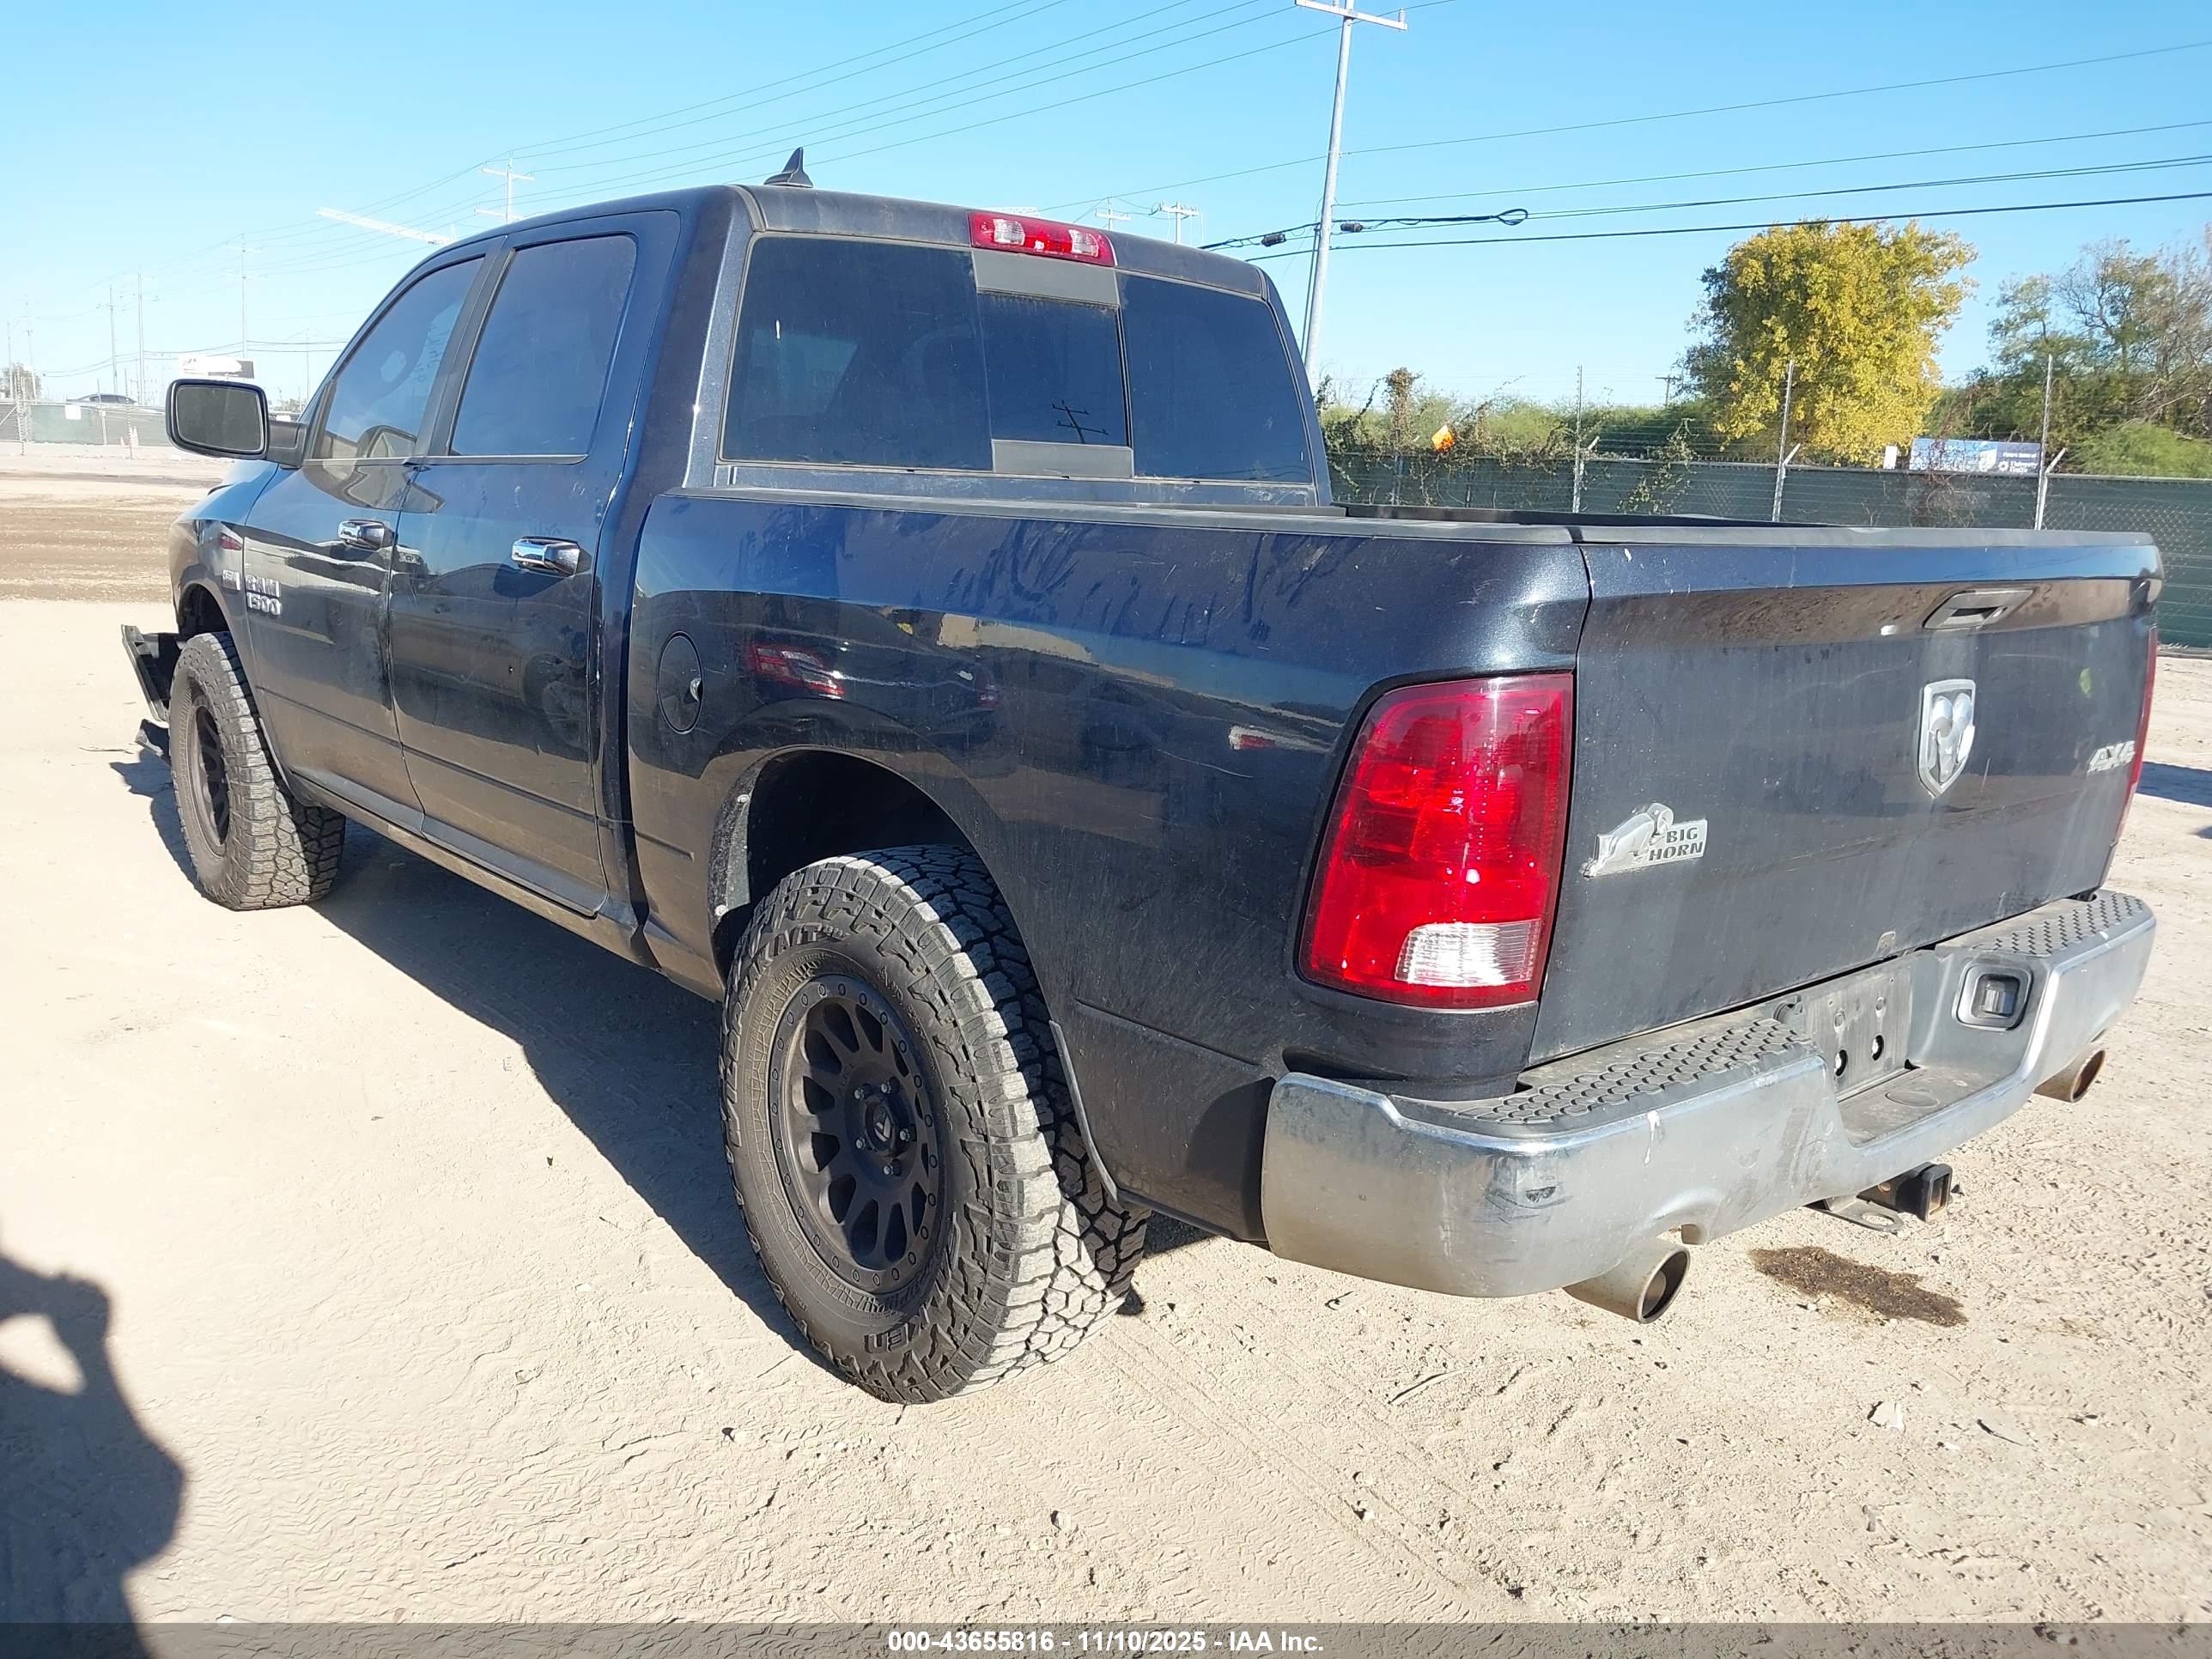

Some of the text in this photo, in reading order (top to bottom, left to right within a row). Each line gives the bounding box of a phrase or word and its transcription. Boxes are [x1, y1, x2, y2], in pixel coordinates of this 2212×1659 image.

[246, 592, 283, 616] 1500
[1667, 827, 1698, 843] BIG
[1649, 842, 1704, 861] HORN
[726, 940, 774, 1148] WILDPEAK
